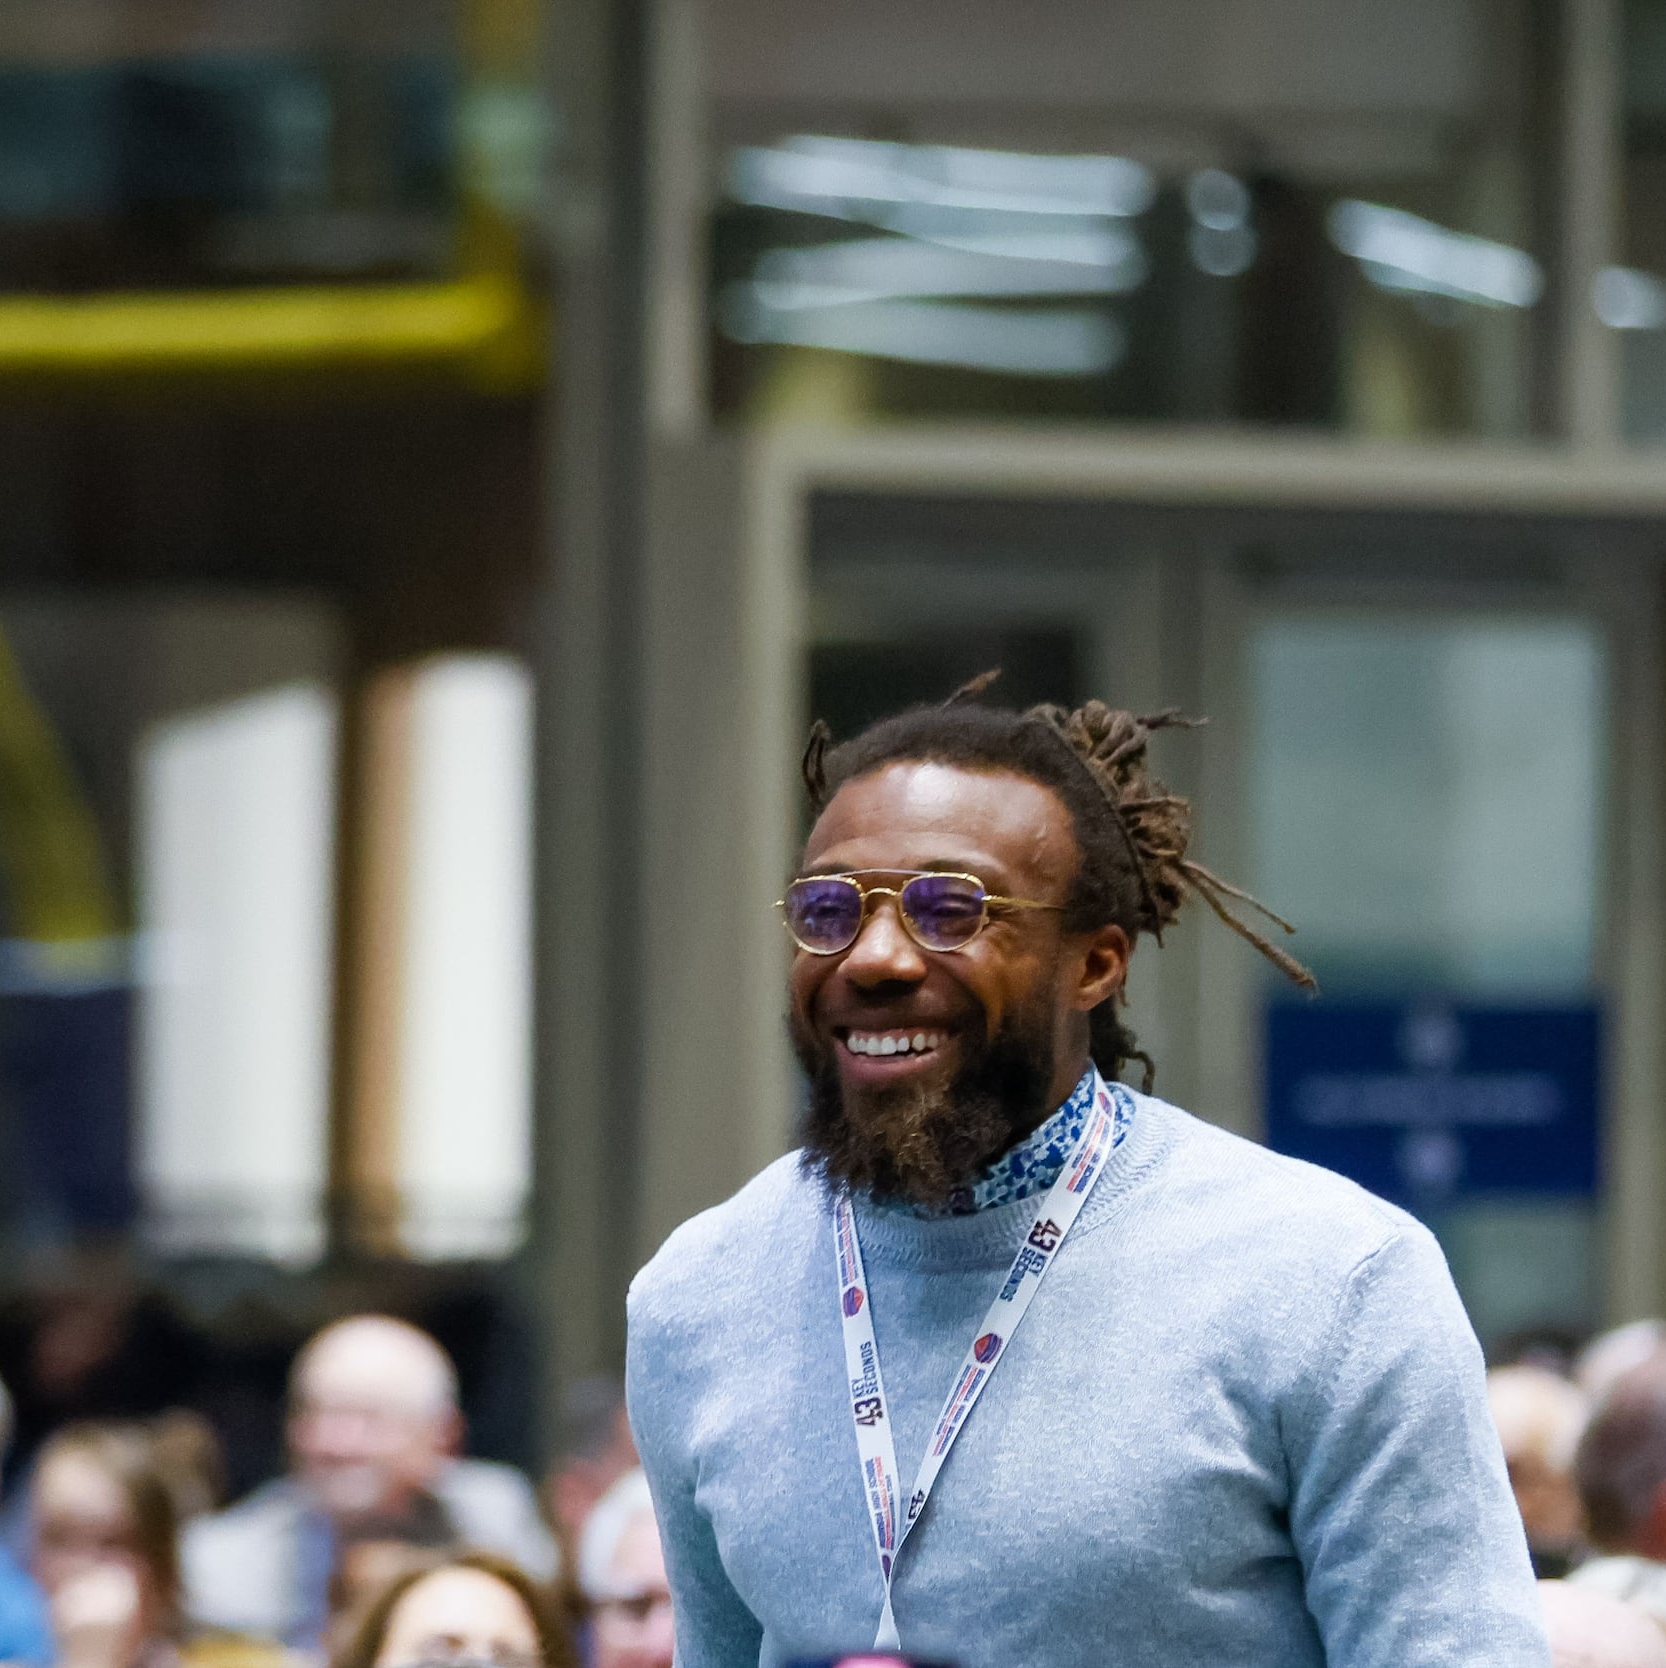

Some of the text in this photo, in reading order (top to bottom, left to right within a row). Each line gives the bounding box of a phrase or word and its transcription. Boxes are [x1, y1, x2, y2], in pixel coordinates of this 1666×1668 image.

[1028, 1218, 1062, 1252] 43
[1000, 1246, 1036, 1302] SECONDS
[1028, 1253, 1048, 1276] KEY
[860, 1341, 879, 1395] SECONDS
[852, 1379, 865, 1398] KEY
[854, 1397, 883, 1426] 43
